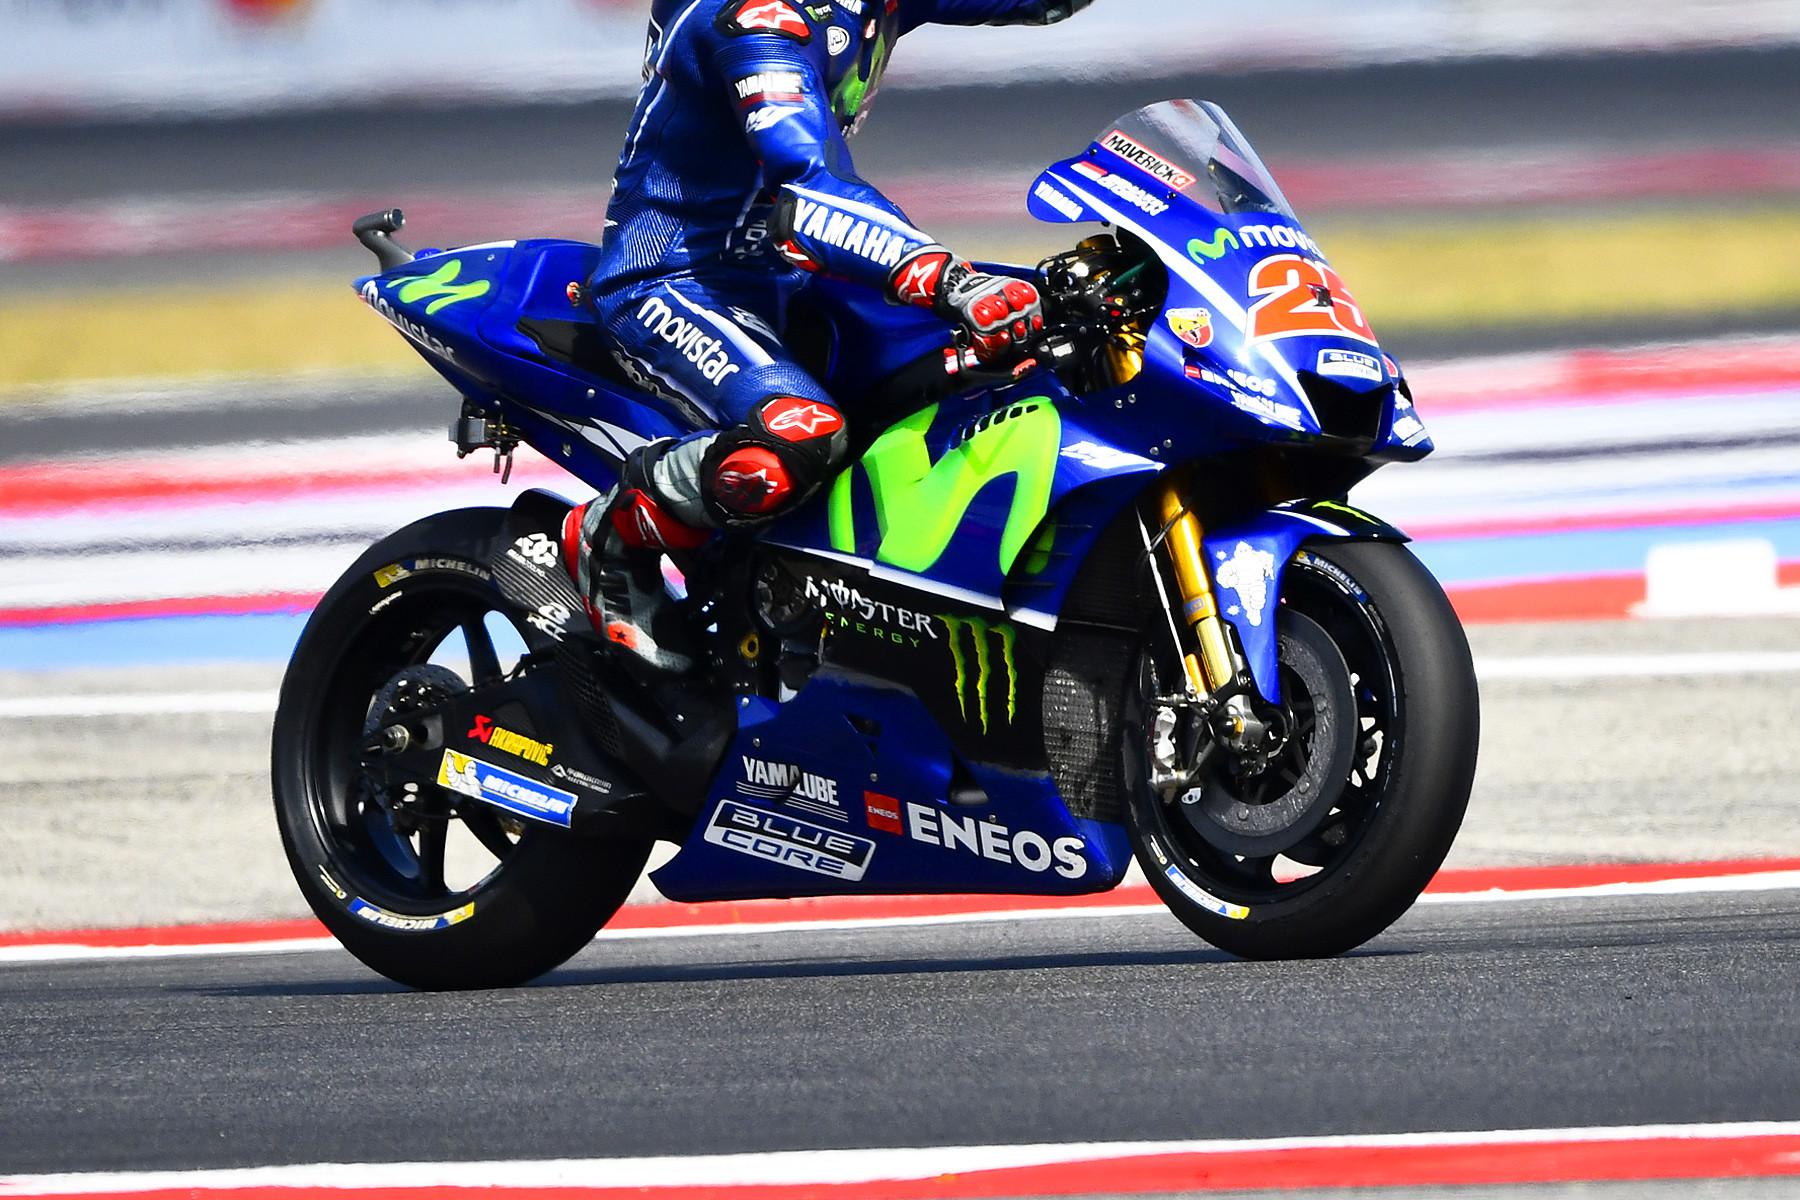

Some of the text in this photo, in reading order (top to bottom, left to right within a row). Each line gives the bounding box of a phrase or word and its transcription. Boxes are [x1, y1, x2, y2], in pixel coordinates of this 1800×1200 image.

[1106, 135, 1178, 181] MAVERICK
[793, 197, 906, 268] YAMAHA
[635, 297, 741, 388] movistar
[413, 558, 491, 581] MICHELIN
[1313, 557, 1363, 596] MICHELIN
[742, 755, 840, 807] YAMALUBE
[722, 829, 846, 875] CORE
[731, 808, 856, 855] BLUE
[867, 802, 1088, 880] ENEOS ENEOS
